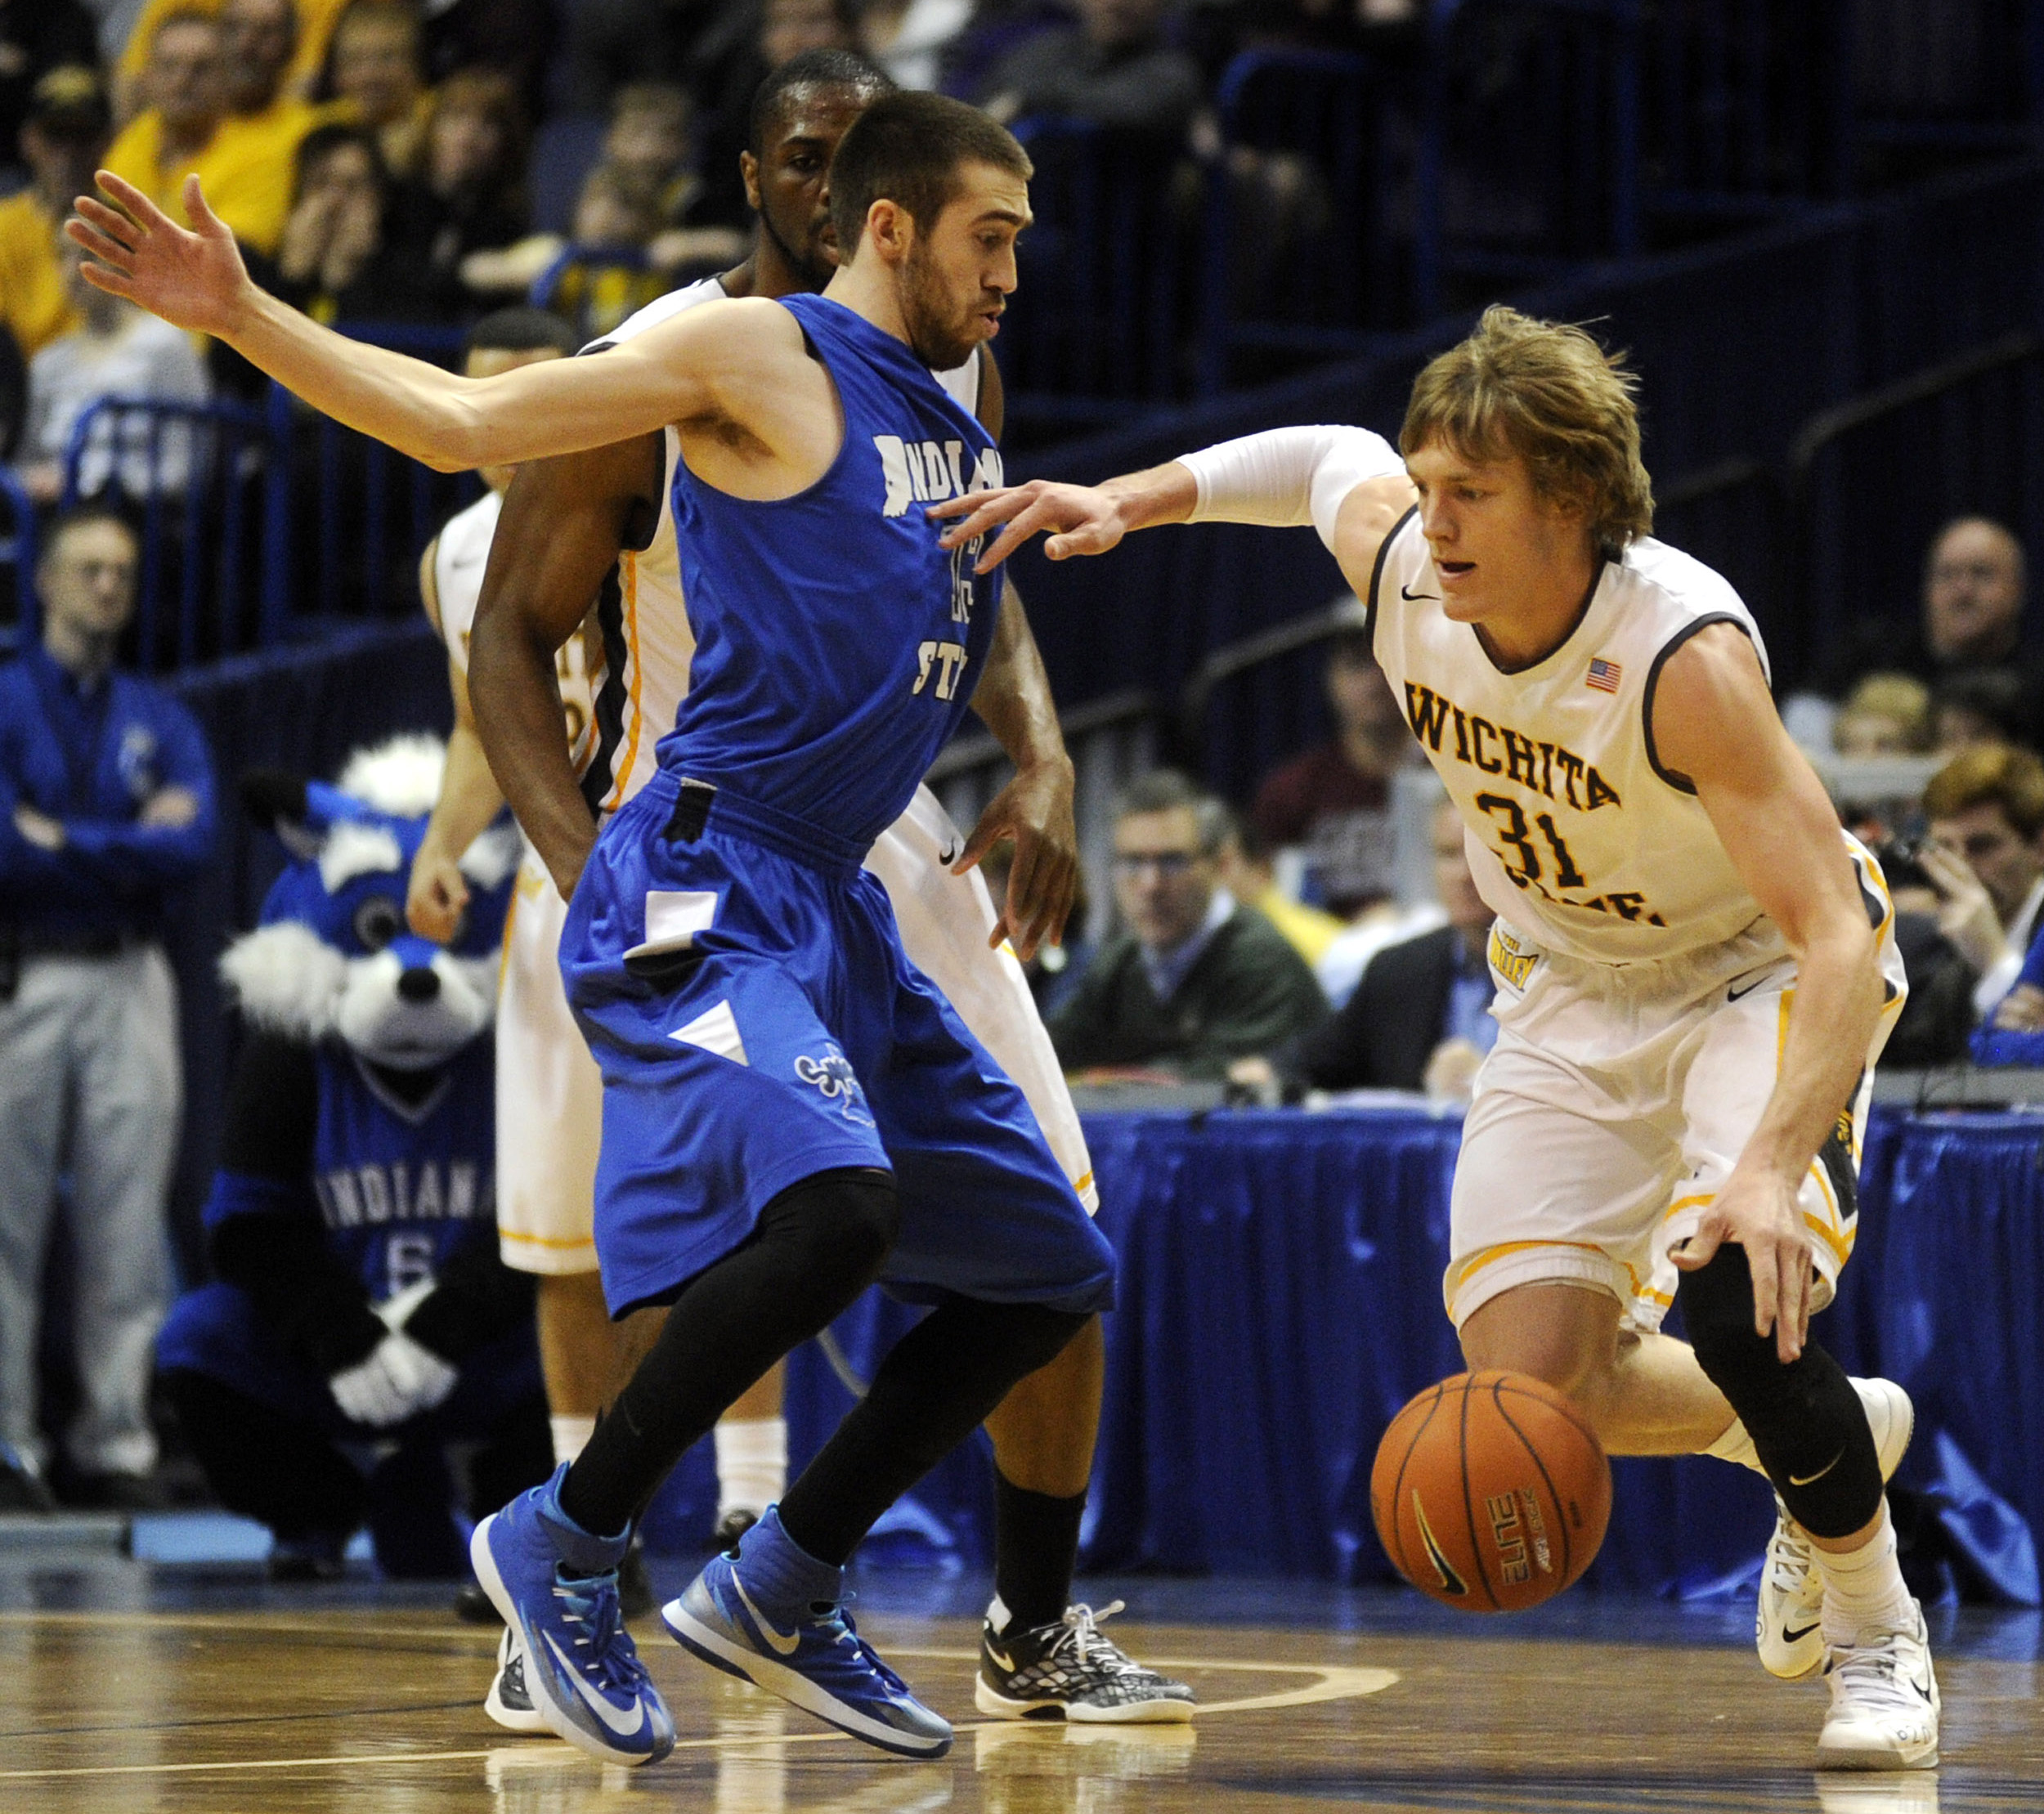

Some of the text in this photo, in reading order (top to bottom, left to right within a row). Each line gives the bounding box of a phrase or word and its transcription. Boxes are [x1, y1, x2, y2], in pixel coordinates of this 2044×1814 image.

[1404, 679, 1621, 812] WICHITA
[1475, 791, 1588, 889] 31
[1486, 1490, 1531, 1585] ELITE
